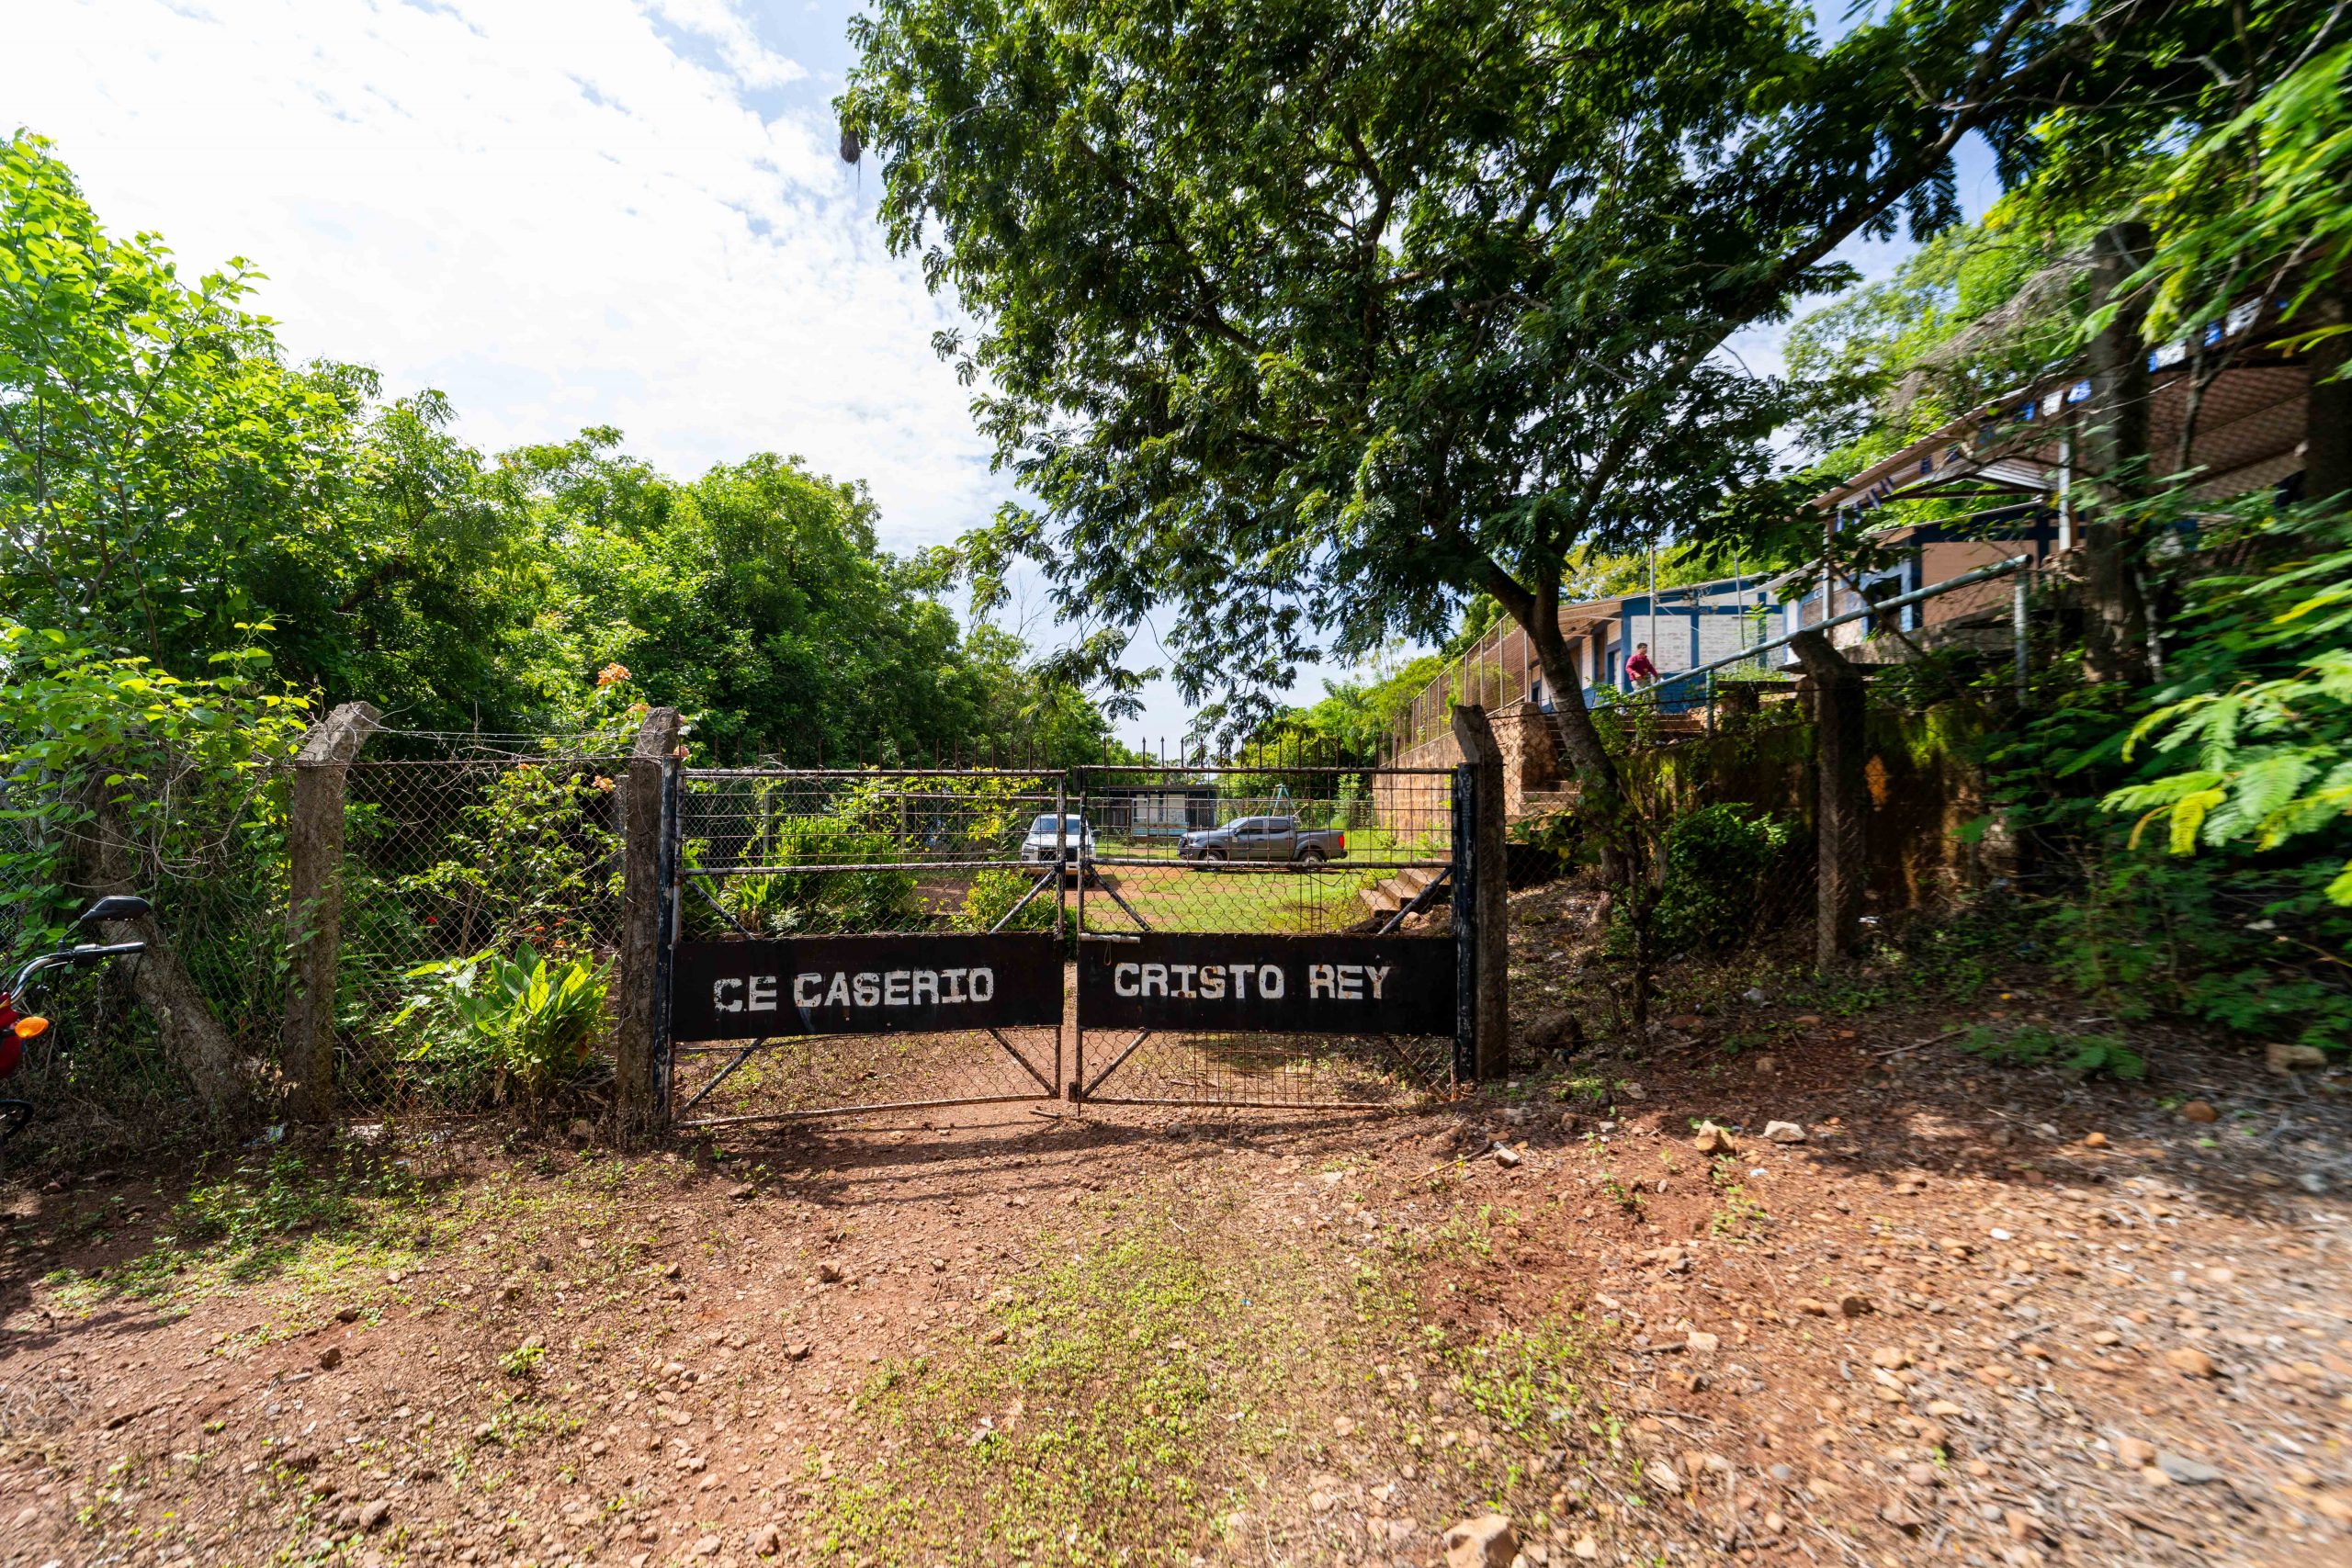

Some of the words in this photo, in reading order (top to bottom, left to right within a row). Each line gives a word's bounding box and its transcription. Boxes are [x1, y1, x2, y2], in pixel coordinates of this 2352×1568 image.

[793, 967, 994, 1008] CASERIO
[1114, 963, 1285, 999] CRISTO
[1308, 964, 1391, 999] REY
